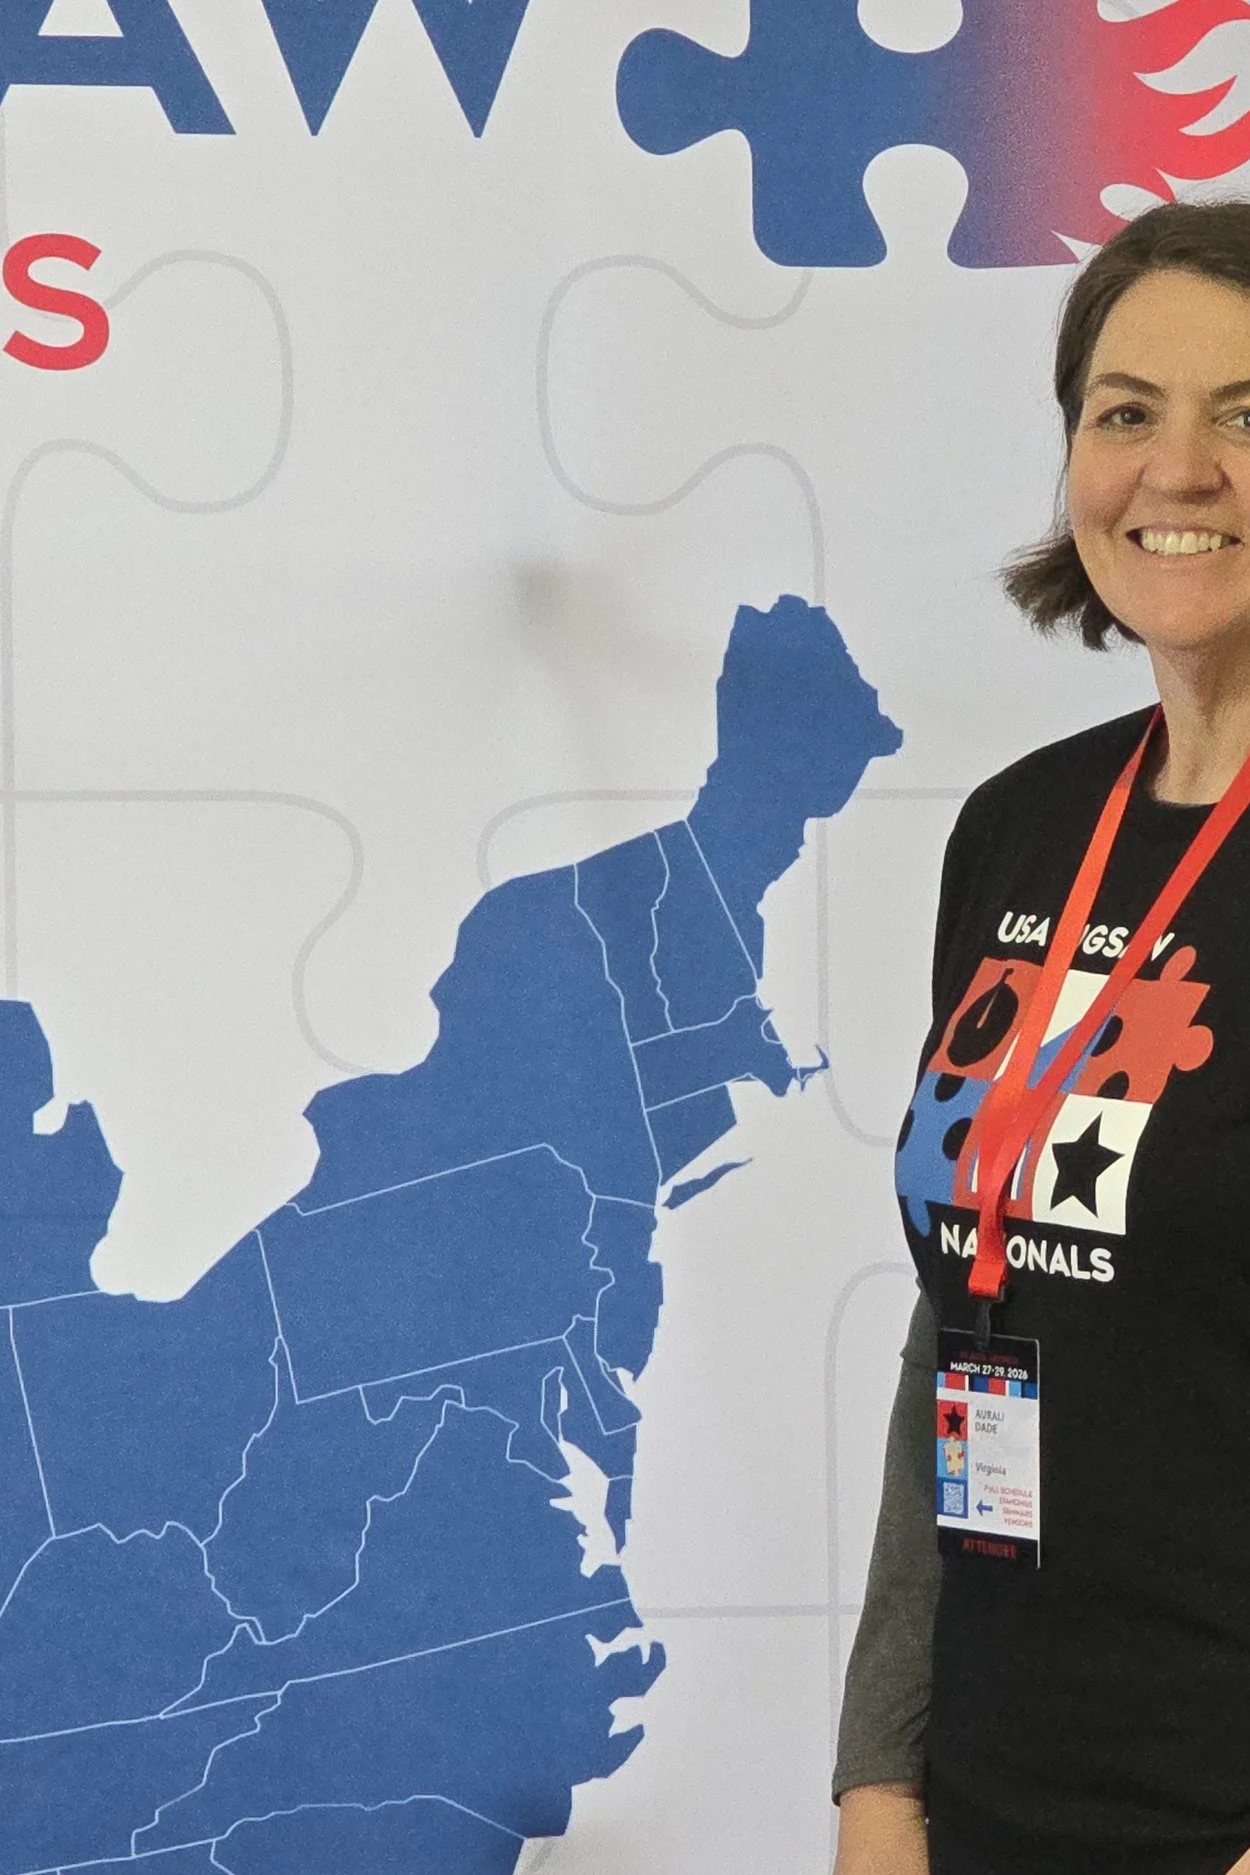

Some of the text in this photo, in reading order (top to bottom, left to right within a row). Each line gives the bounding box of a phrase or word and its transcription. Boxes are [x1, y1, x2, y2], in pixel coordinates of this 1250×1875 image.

[2, 233, 110, 371] S
[997, 911, 1050, 947] USA
[940, 1221, 1115, 1283] NAONALS
[949, 1361, 980, 1374] MARCH
[1007, 1367, 1029, 1380] 2026
[974, 1421, 998, 1434] DADE
[975, 1461, 1007, 1477] Virginia
